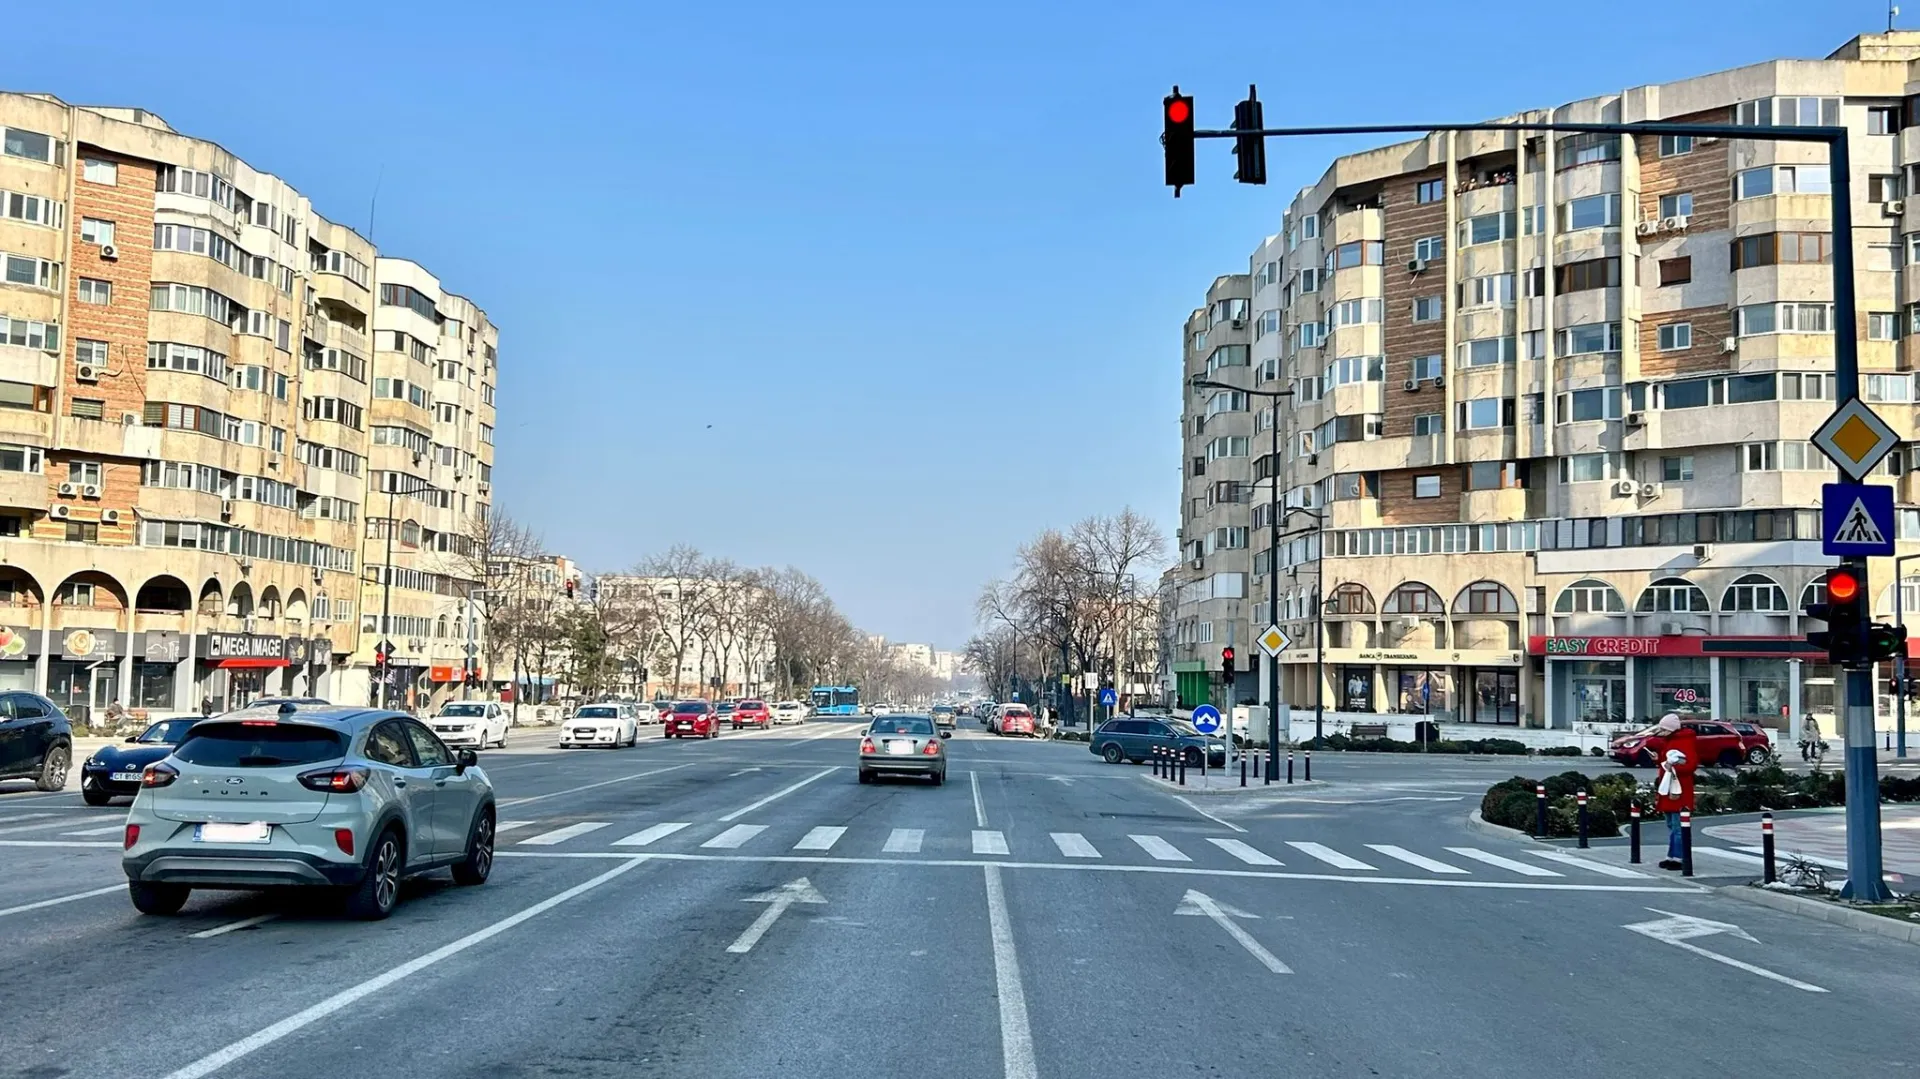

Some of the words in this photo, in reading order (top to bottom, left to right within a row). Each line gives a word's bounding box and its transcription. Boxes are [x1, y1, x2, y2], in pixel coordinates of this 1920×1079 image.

[221, 636, 250, 656] MEGA
[251, 638, 281, 657] IMAGE
[1546, 638, 1591, 653] EASY
[1593, 638, 1660, 654] CREDIT
[1674, 688, 1697, 703] 48
